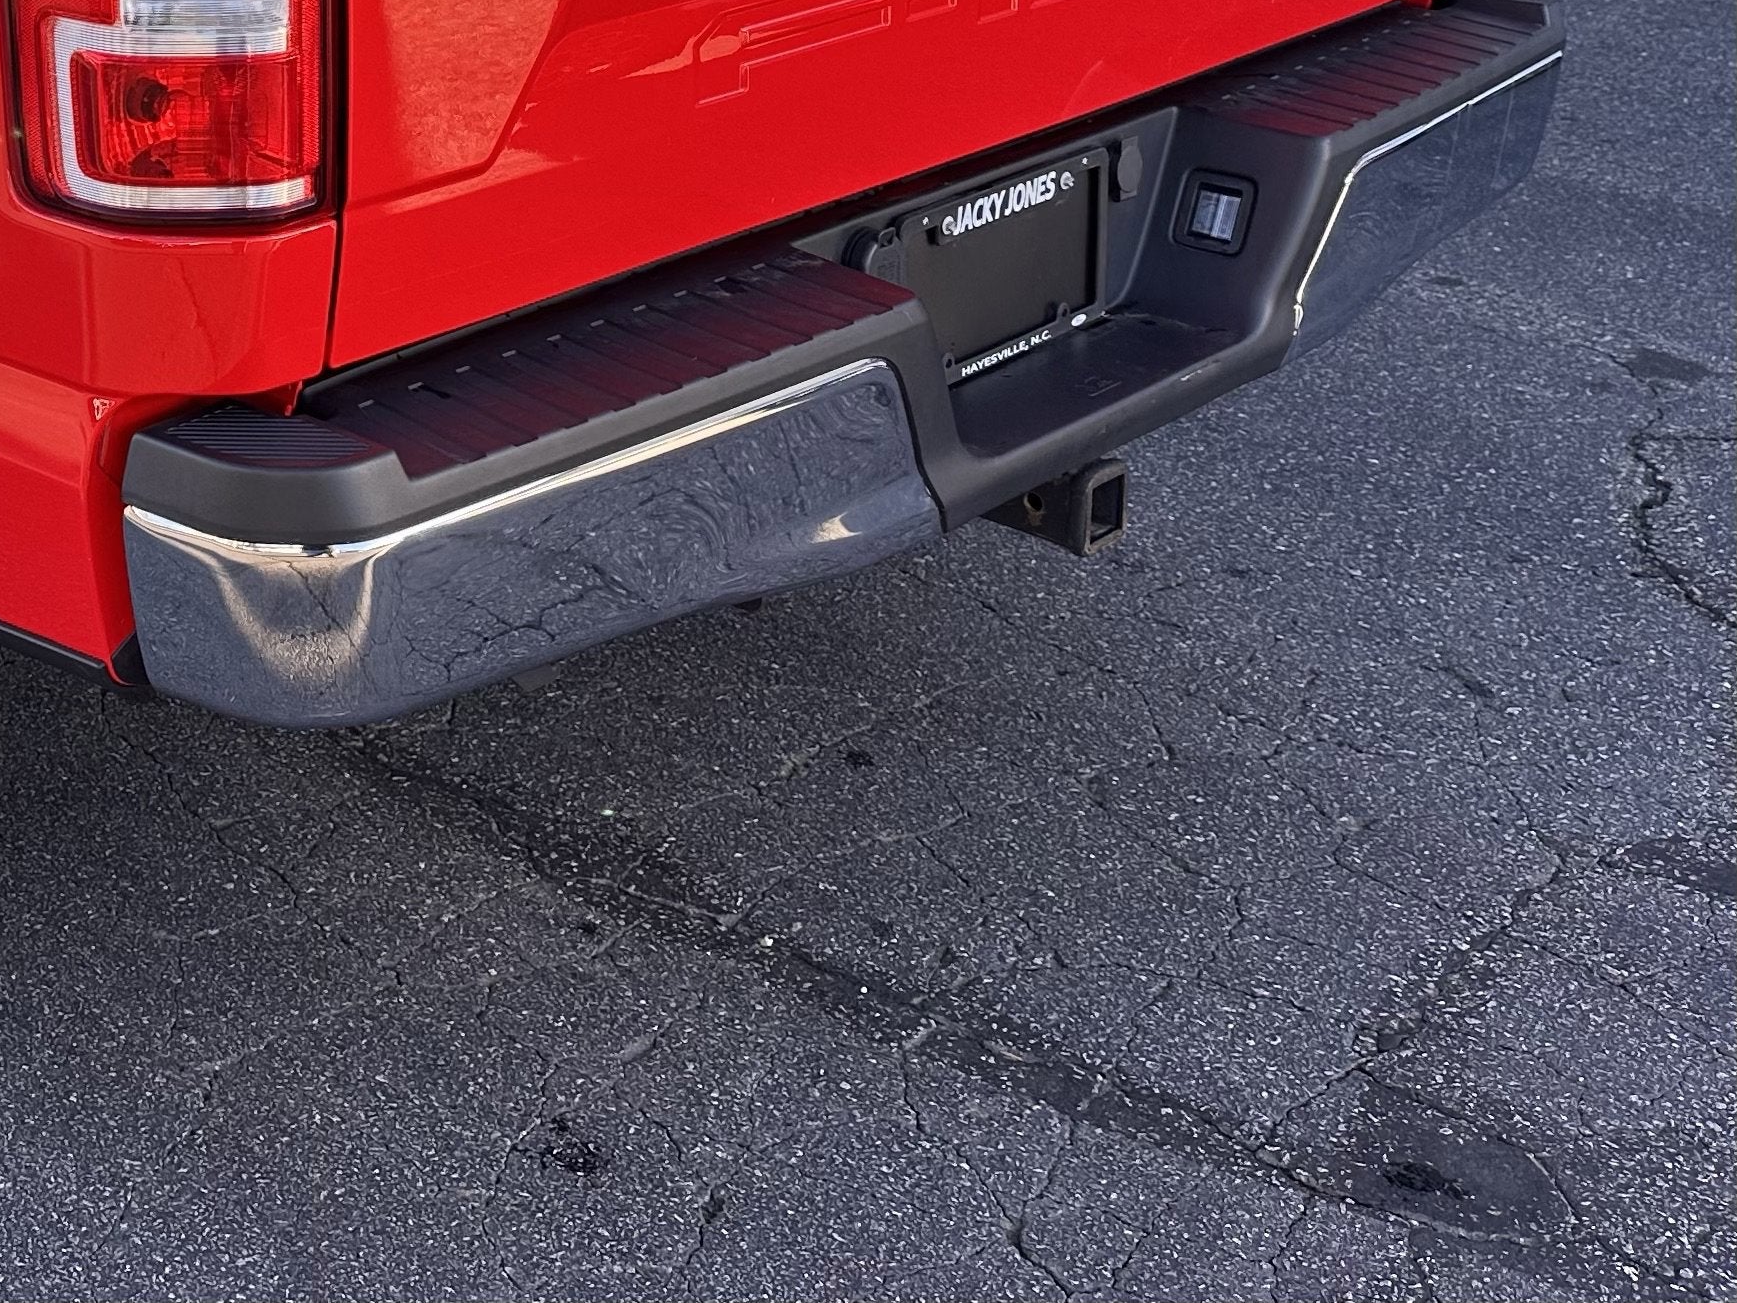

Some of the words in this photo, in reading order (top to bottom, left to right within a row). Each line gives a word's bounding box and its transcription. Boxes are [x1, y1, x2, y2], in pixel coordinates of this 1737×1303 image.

[952, 189, 1007, 236] JACKY
[1004, 170, 1057, 217] JONES
[961, 340, 1029, 377] HAYESVILLE,
